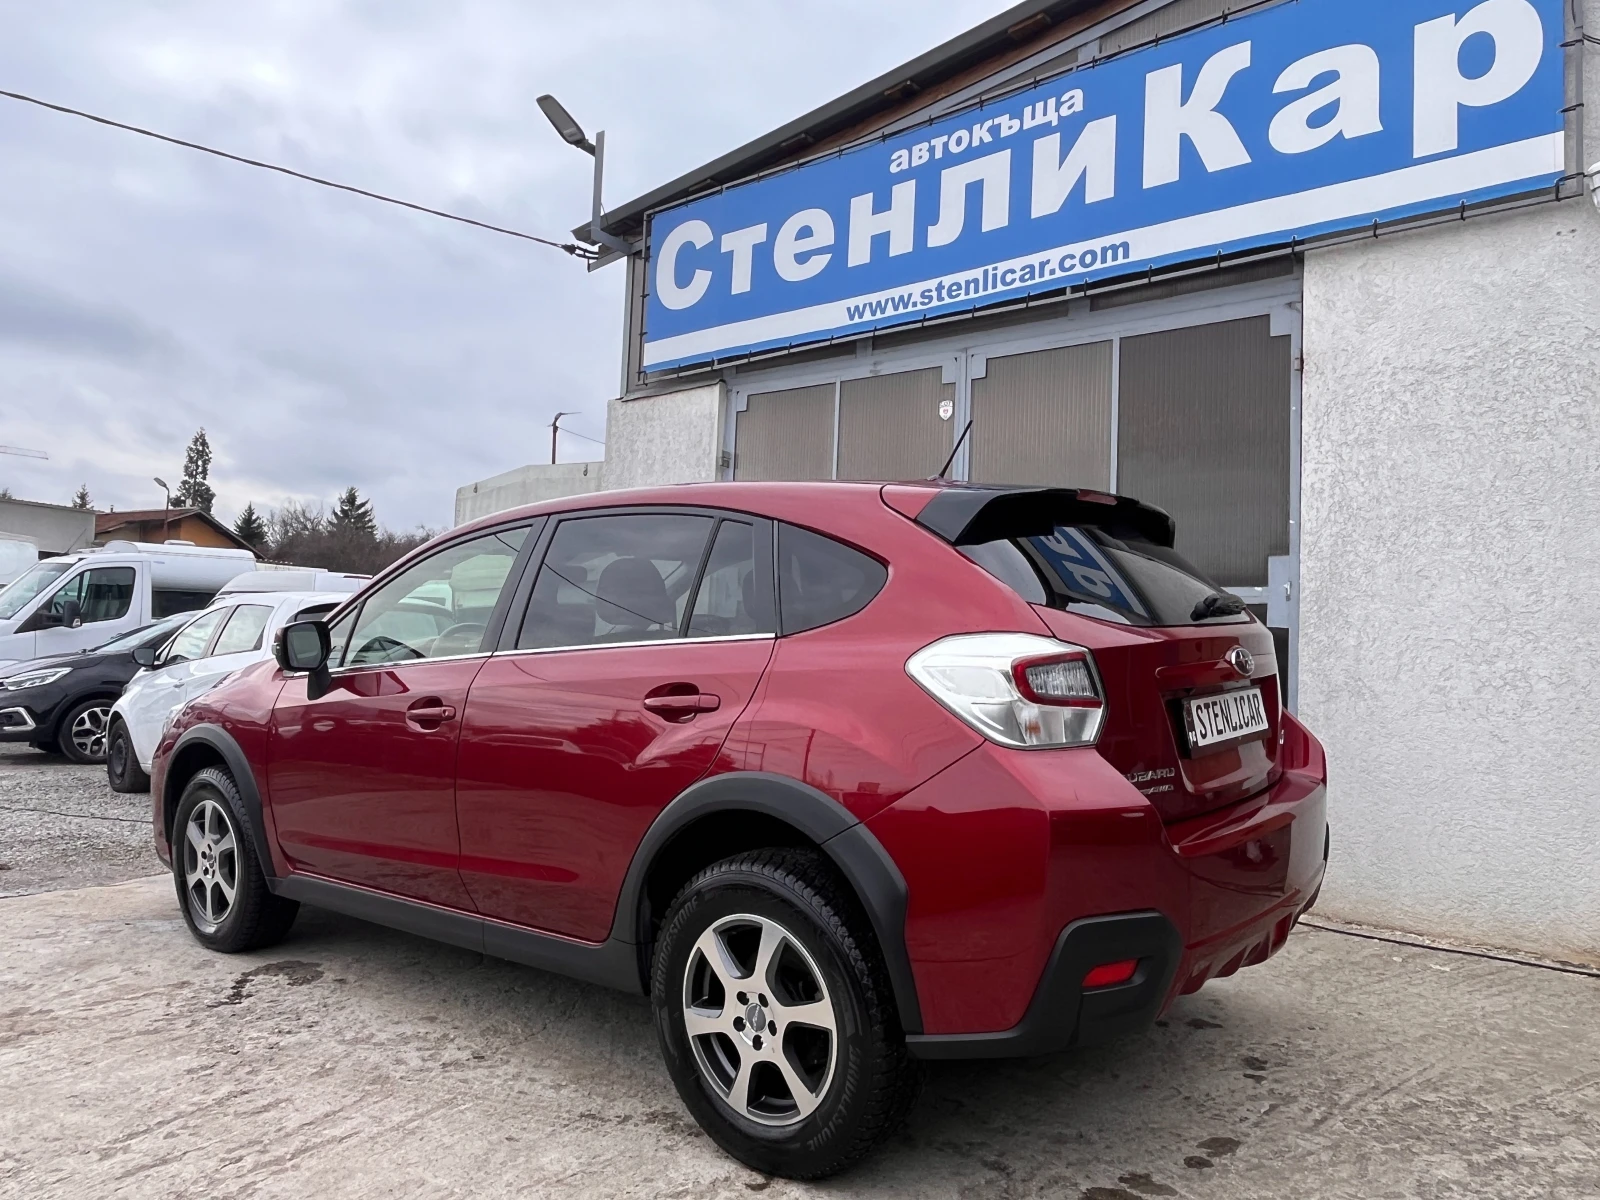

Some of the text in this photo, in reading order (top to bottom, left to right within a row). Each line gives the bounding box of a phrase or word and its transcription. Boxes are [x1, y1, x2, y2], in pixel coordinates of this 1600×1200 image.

[889, 88, 1084, 174] автокъща
[846, 240, 1130, 322] www.stenlicar.com
[1195, 693, 1264, 740] STENLICAR
[1125, 767, 1175, 783] UBARU
